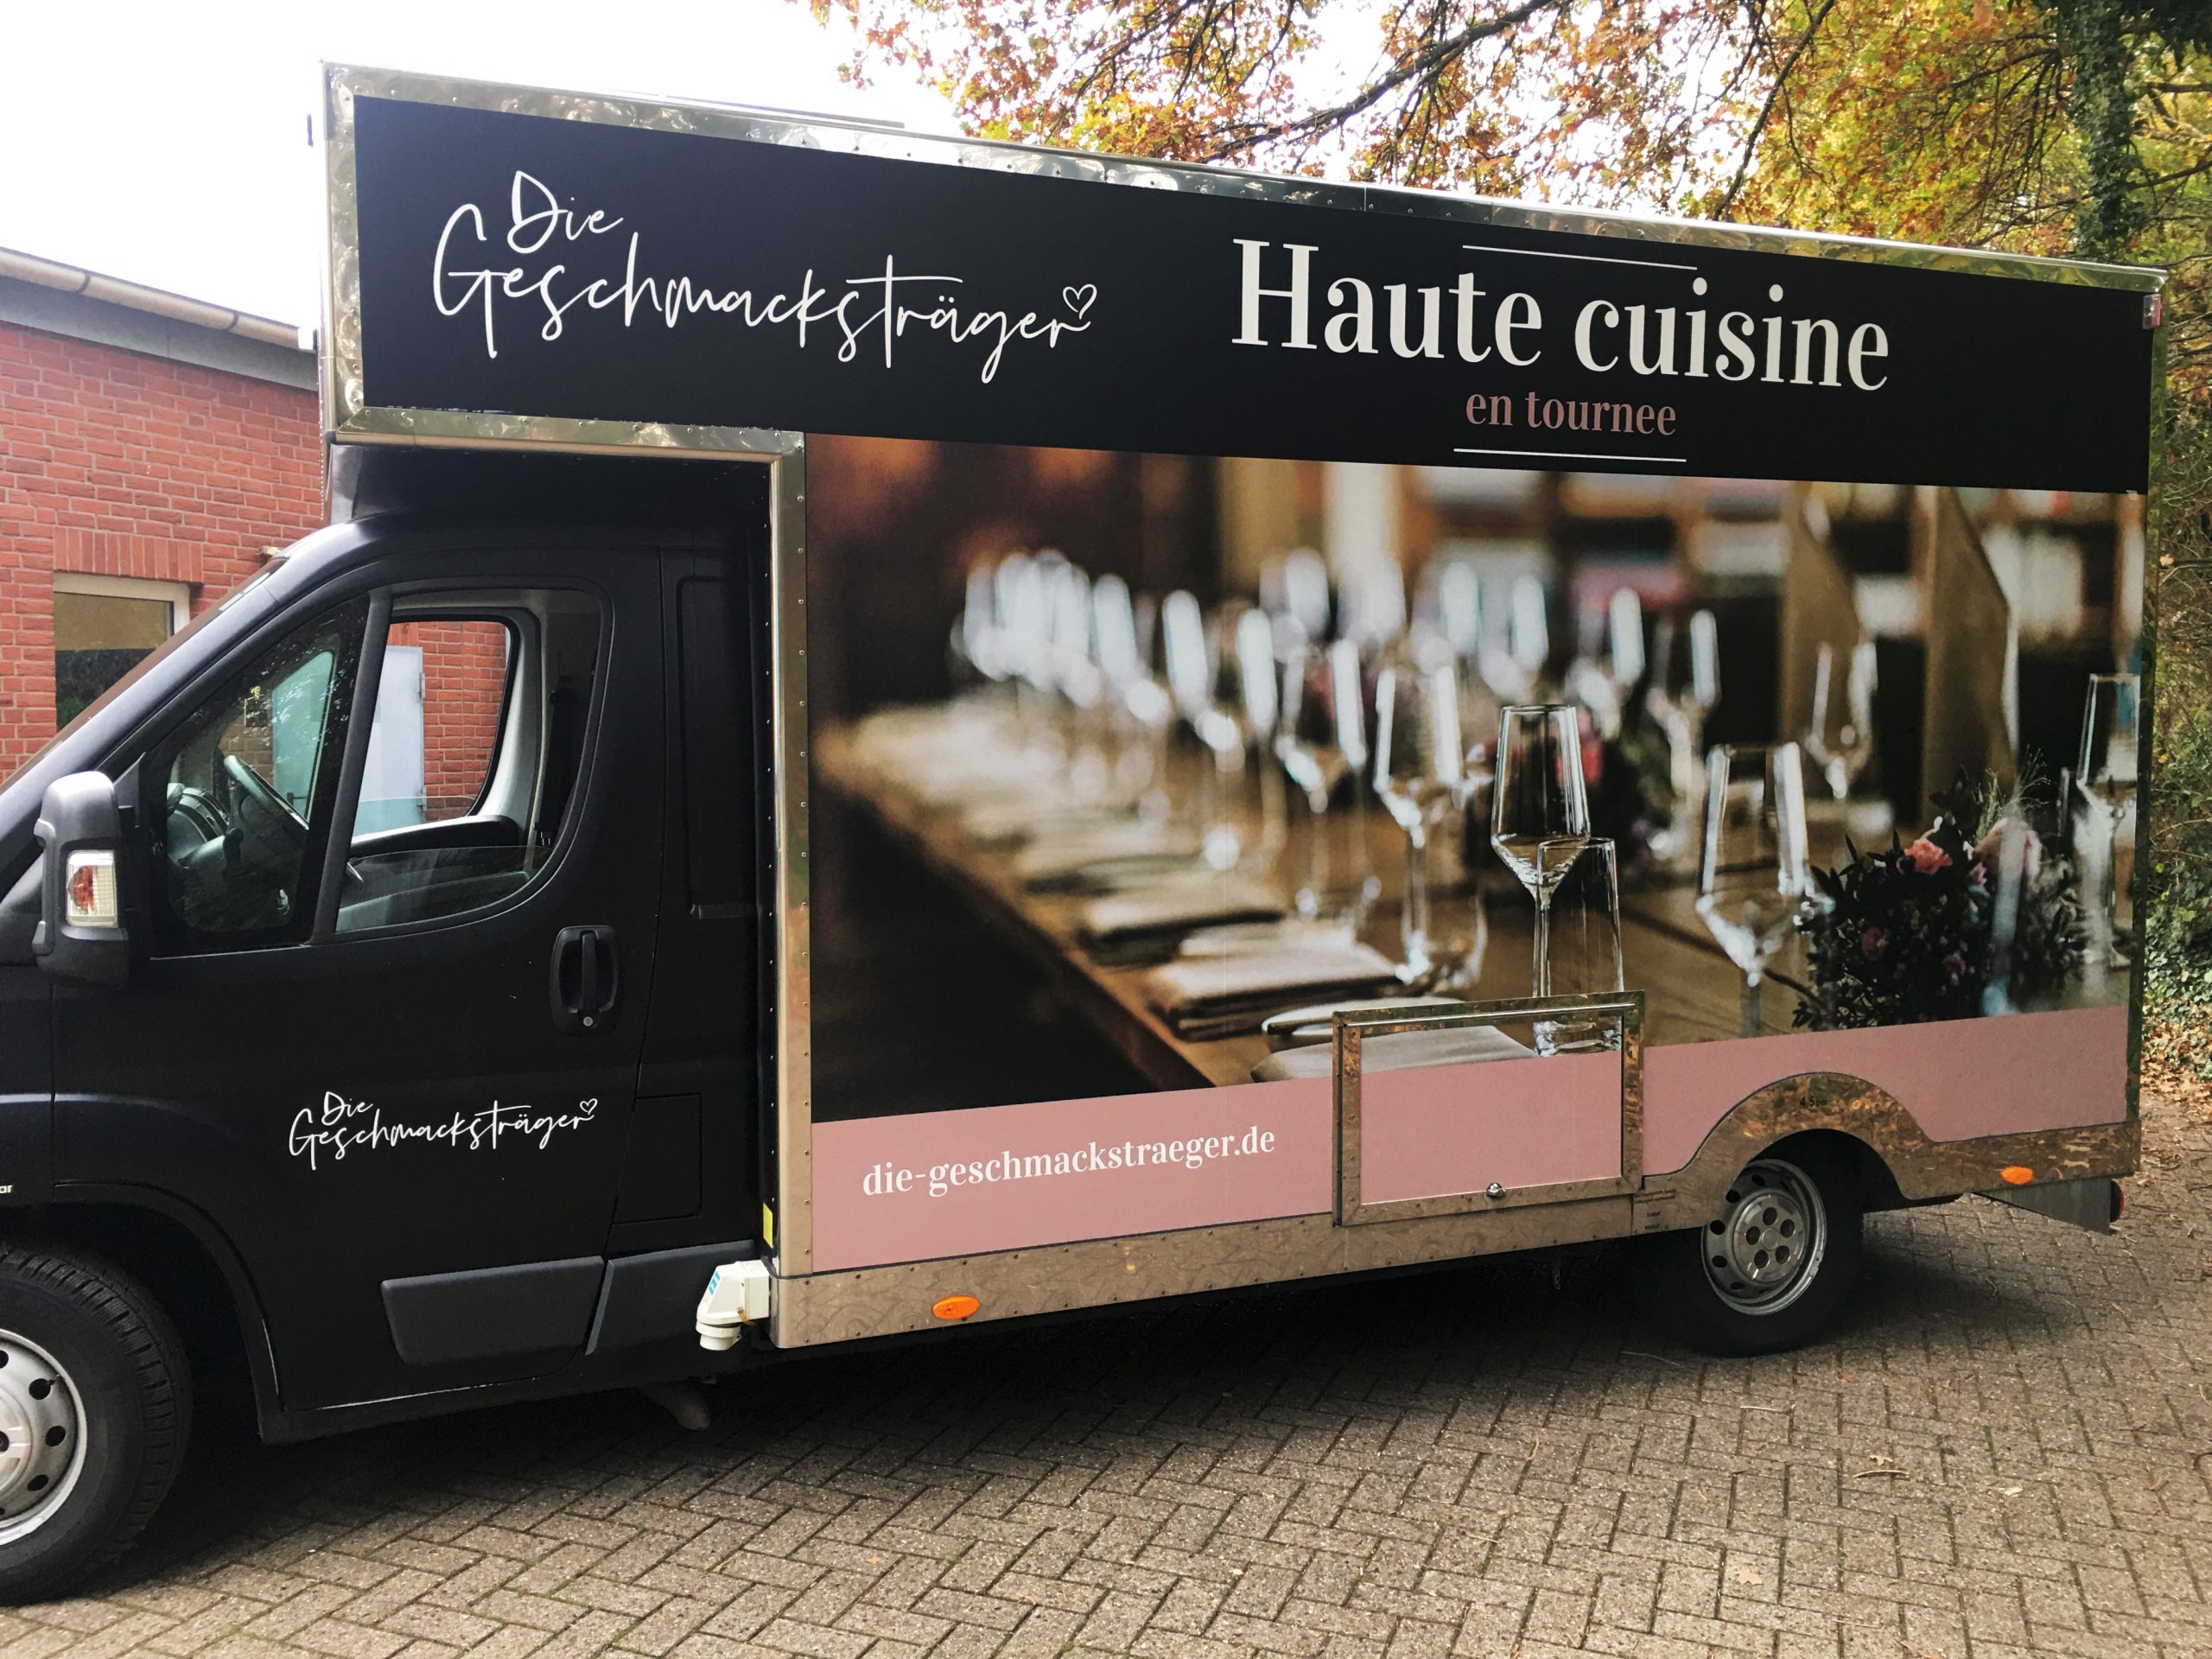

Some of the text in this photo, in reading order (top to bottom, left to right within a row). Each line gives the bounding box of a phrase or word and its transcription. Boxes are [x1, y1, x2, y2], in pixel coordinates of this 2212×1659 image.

[506, 169, 624, 254] Die
[433, 203, 1091, 384] Geschmacksträger
[1231, 238, 1889, 391] Haute cuisine
[1465, 391, 1676, 435] en tournee
[289, 1100, 595, 1171] Geschmacksträger
[321, 1090, 374, 1126] Die
[0, 1184, 13, 1194] ar
[862, 1125, 1276, 1198] die-geschmackstraeger.de
